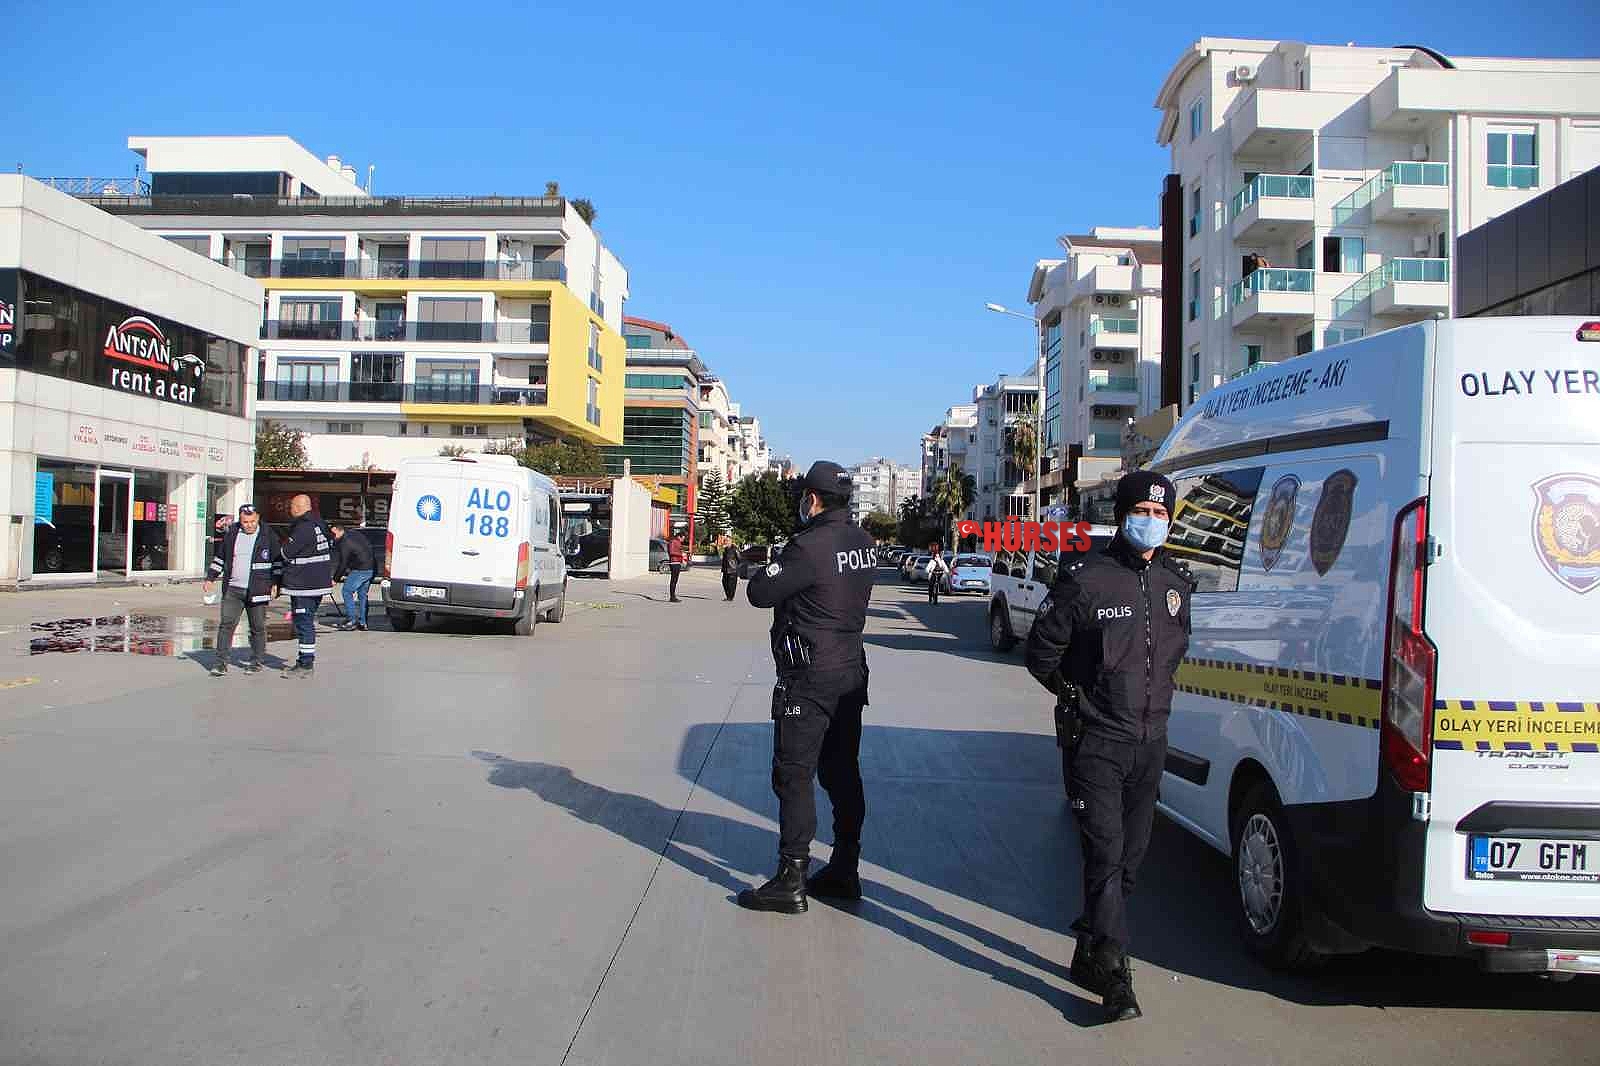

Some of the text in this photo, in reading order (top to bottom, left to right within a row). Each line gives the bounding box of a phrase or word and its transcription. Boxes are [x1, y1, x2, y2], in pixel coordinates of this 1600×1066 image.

[105, 325, 171, 365] ANTSAN
[112, 368, 196, 403] rent a car
[1460, 370, 1536, 397] OLAY
[467, 488, 511, 511] ALO
[465, 513, 509, 537] 188
[1440, 718, 1482, 732] OLAY
[1475, 750, 1569, 759] TRANSIT
[1490, 841, 1521, 869] 07
[1539, 843, 1586, 871] GFM
